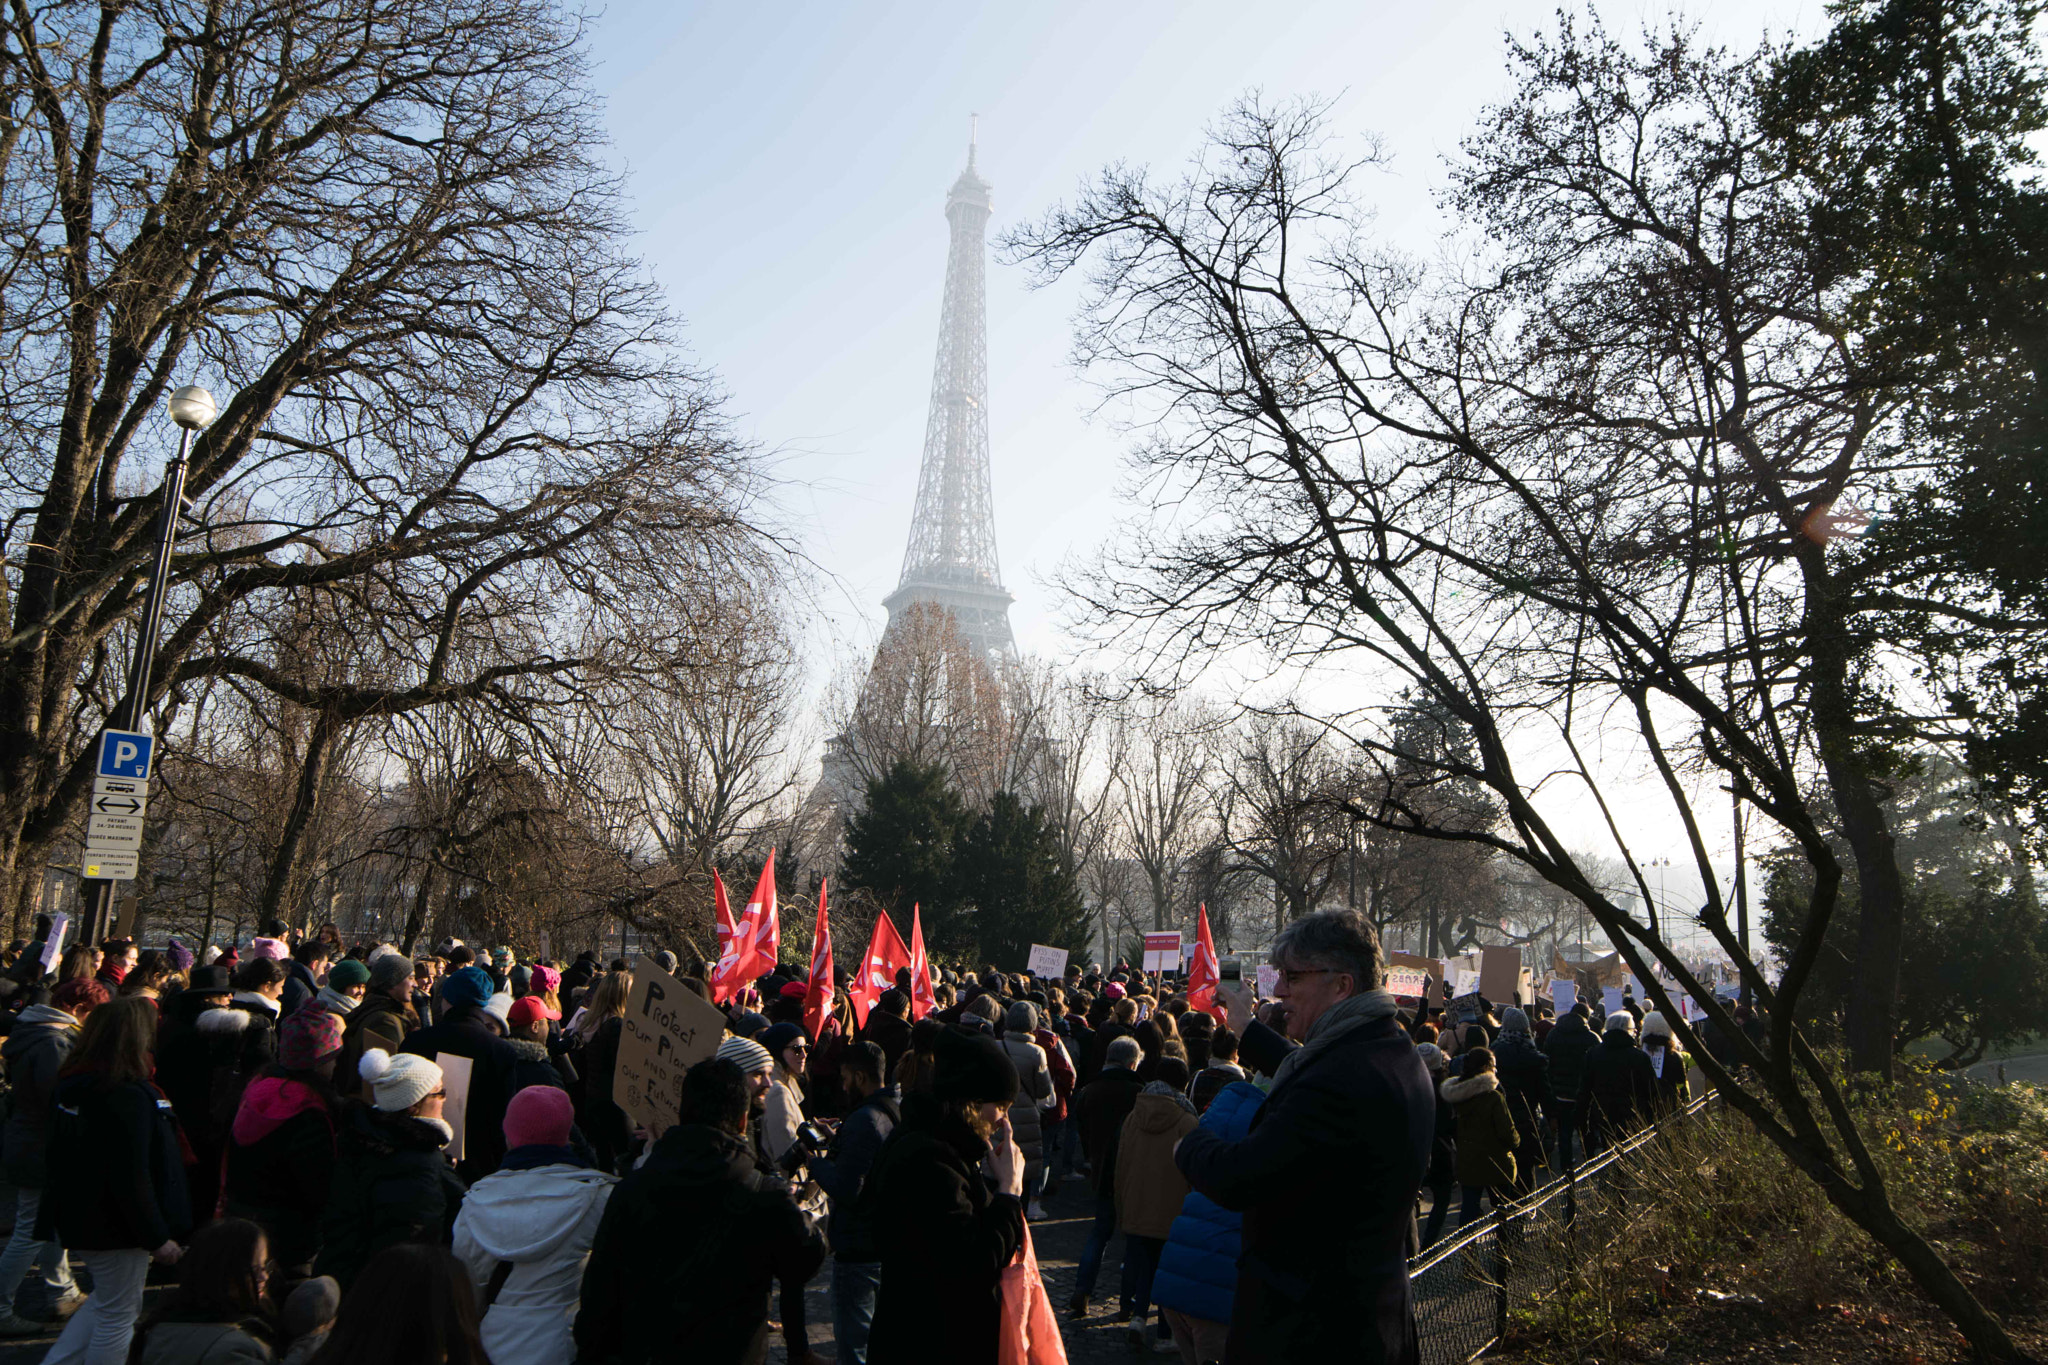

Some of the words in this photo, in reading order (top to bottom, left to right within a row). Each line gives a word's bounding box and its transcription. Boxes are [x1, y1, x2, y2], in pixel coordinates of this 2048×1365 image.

[113, 740, 138, 769] P
[1051, 950, 1062, 959] ON
[643, 1058, 666, 1081] AND
